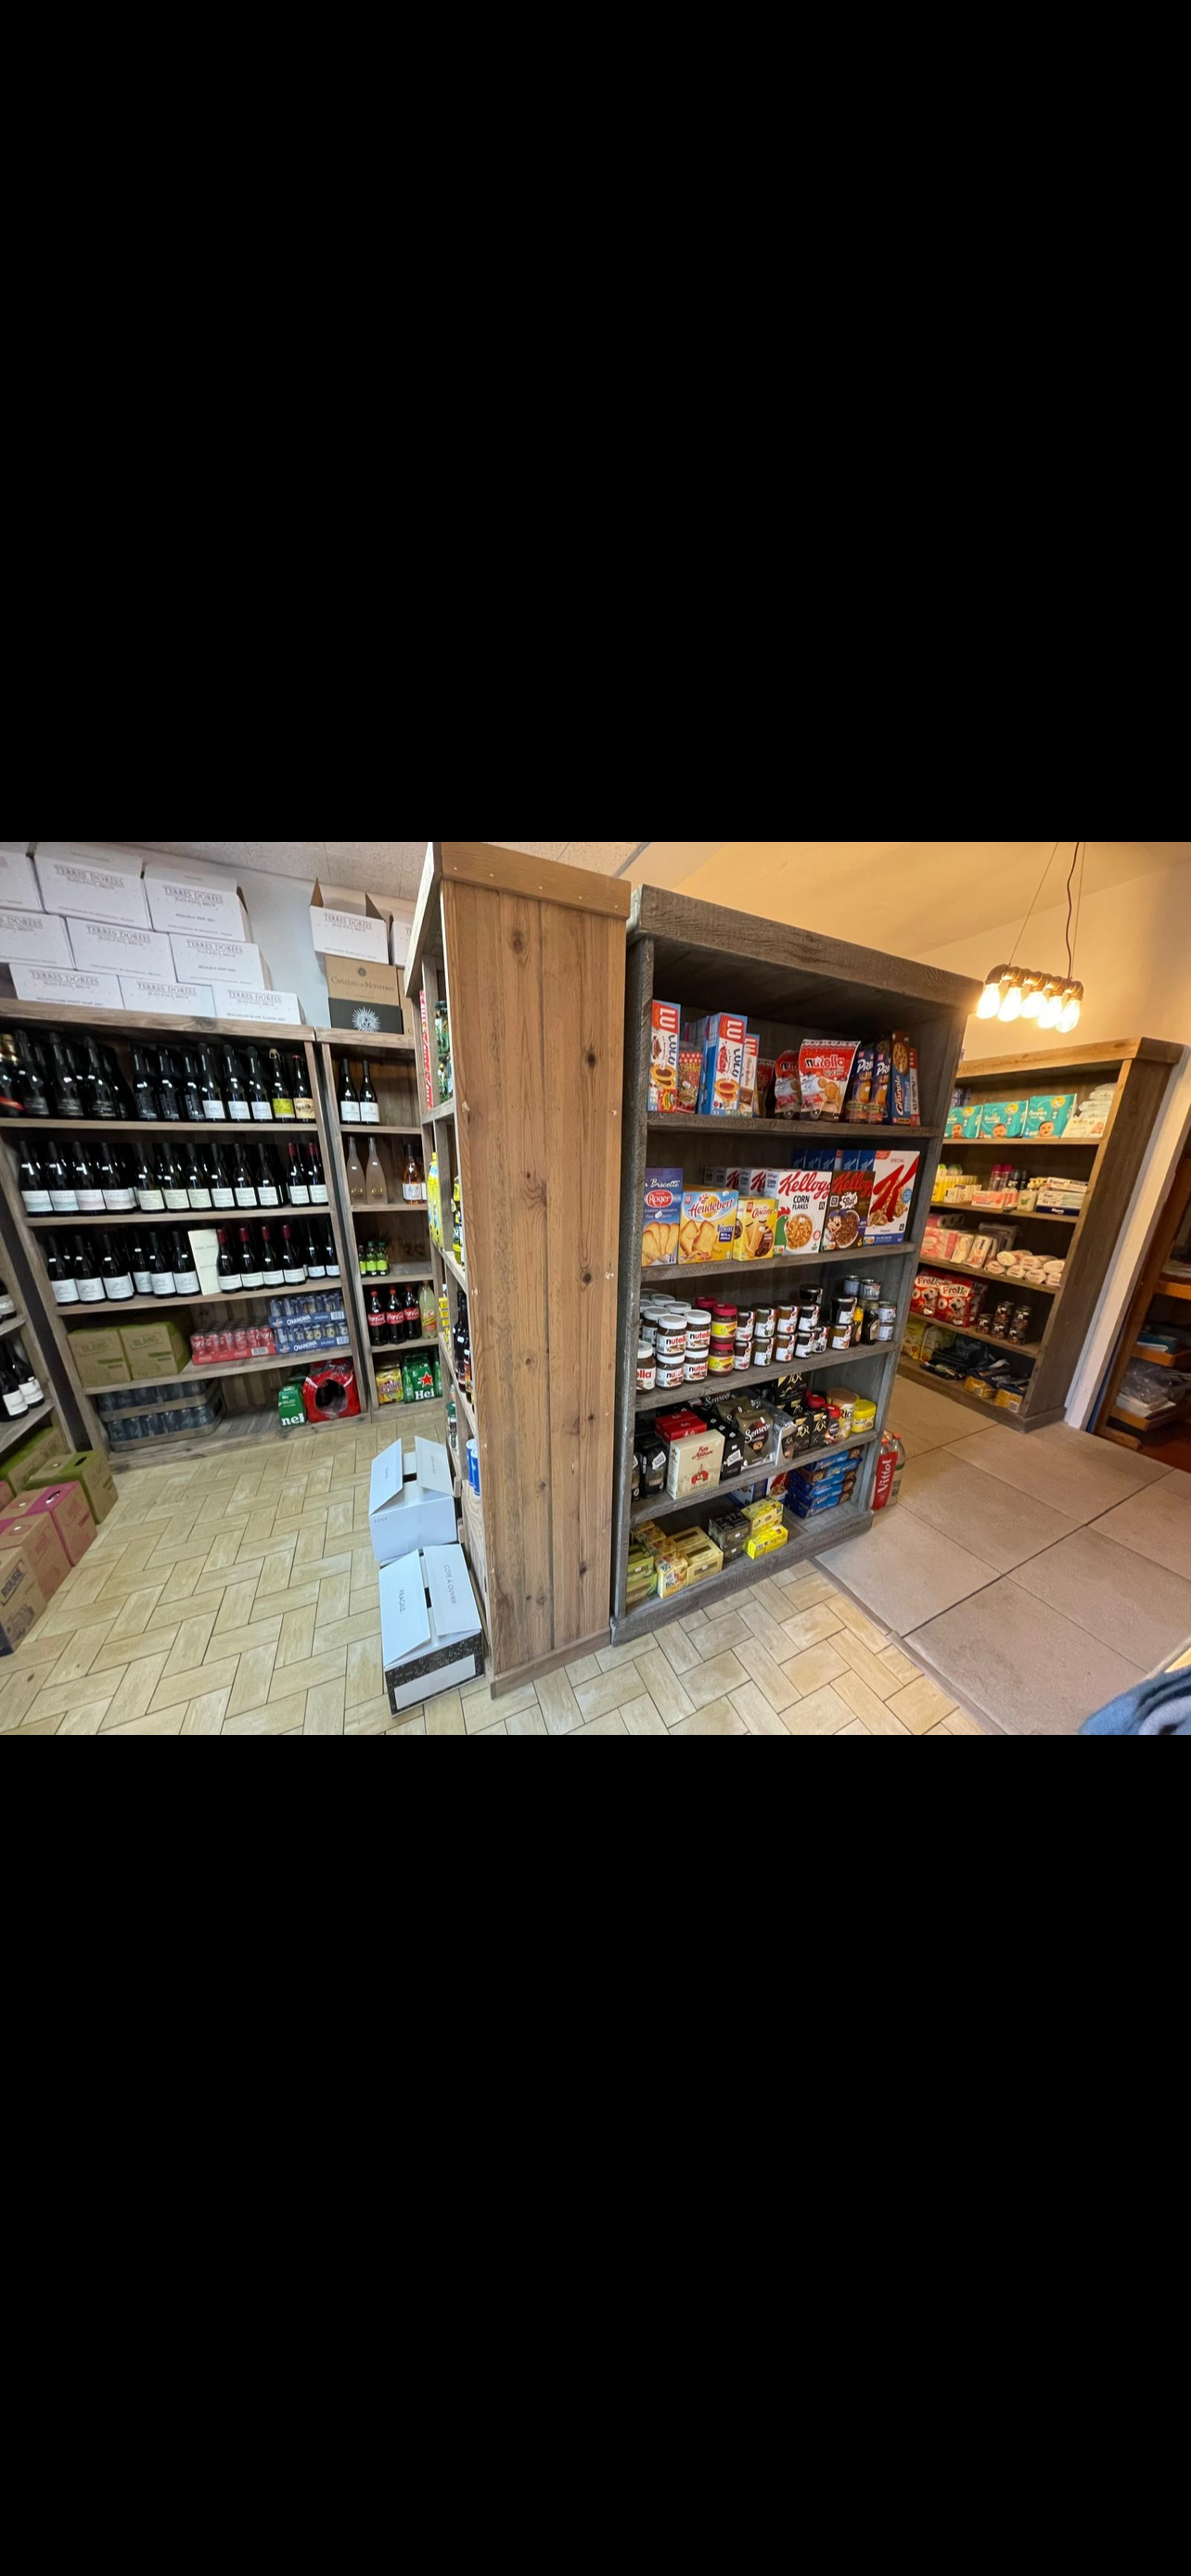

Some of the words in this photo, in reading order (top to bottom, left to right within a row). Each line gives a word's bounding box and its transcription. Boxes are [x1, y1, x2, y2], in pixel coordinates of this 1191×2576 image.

[660, 1007, 675, 1029] LU
[726, 1020, 743, 1039] LU
[668, 1034, 677, 1065] LULU
[732, 1048, 741, 1078] LULU
[805, 1053, 845, 1068] nutella
[648, 1192, 672, 1205] Roger
[869, 1154, 920, 1223] K
[687, 1197, 735, 1218] Heudebert
[792, 1195, 810, 1204] CORN
[745, 1423, 772, 1443] Senseo
[1, 1566, 24, 1597] ROUGE
